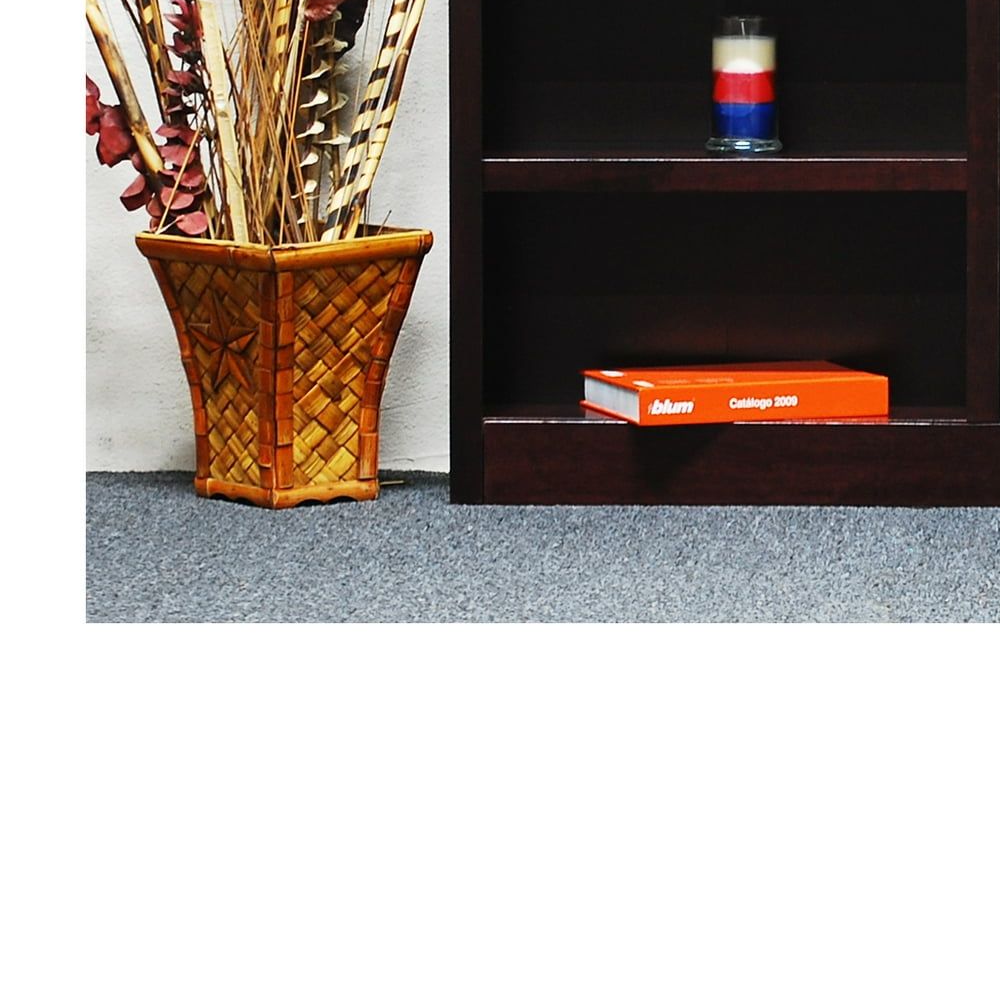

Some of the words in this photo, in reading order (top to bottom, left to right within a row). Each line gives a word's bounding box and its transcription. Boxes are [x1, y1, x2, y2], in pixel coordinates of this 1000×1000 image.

[651, 398, 695, 415] blum
[729, 396, 773, 410] Catálogo
[773, 395, 798, 408] 2009
